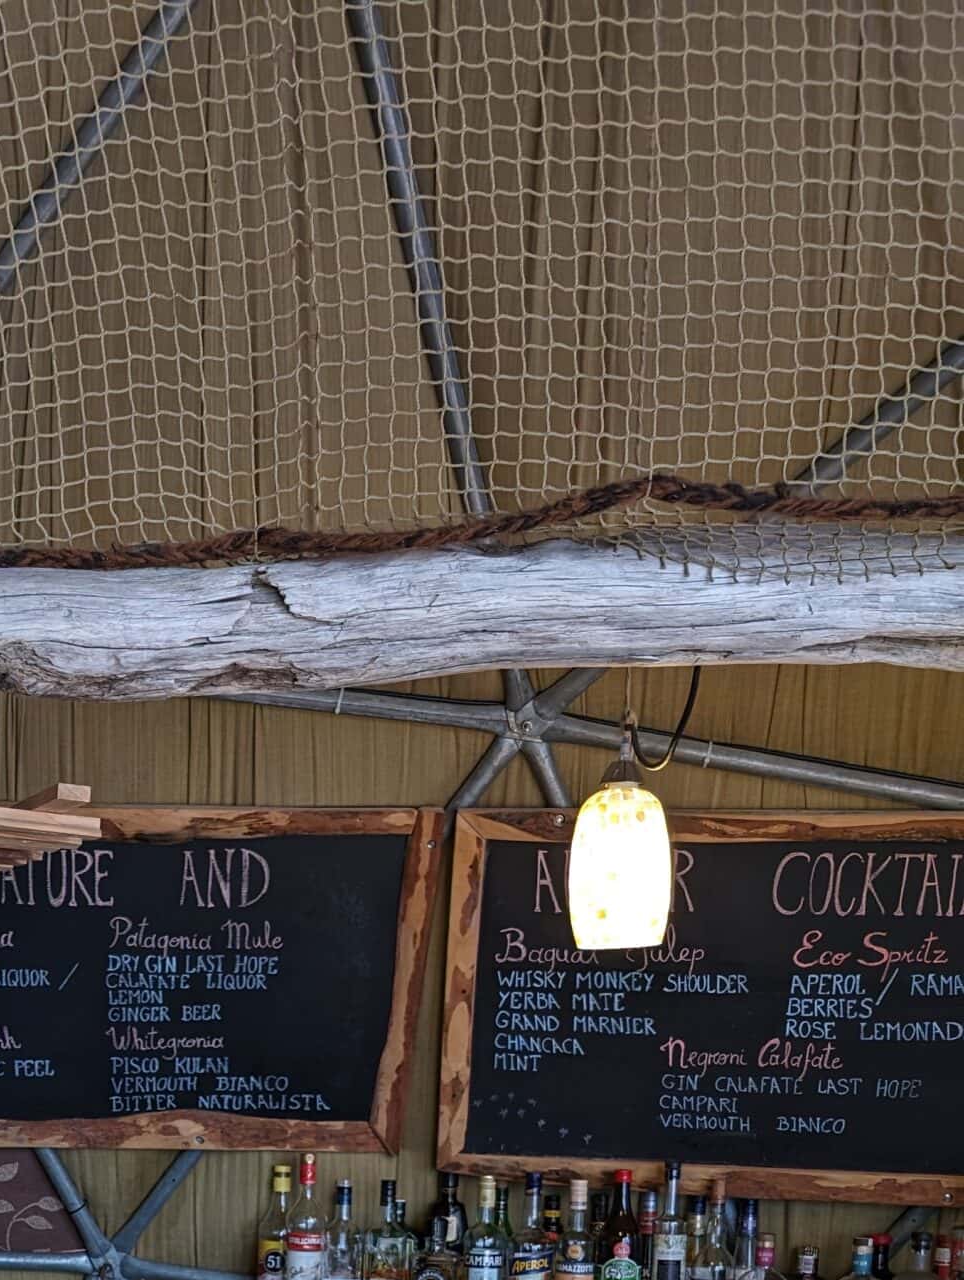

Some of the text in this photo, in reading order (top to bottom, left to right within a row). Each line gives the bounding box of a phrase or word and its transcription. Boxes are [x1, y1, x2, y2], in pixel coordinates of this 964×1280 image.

[180, 848, 270, 909] AND
[772, 852, 964, 917] COCKTAI
[109, 916, 284, 958] Patagonia Mule
[107, 954, 279, 975] DRY GIN LAST HOPE
[793, 929, 949, 983] Eco Spritz
[206, 973, 267, 990] LIQUOR
[496, 970, 749, 994] WHISKY MONKEY SHOULDER
[790, 973, 866, 996] APEROL
[108, 989, 164, 1006] LEMON
[498, 991, 626, 1011] YERBA MATE
[108, 1004, 222, 1022] GINGER BEER
[786, 998, 874, 1019] BERRIES
[495, 1011, 657, 1035] GRAND MARNIER
[785, 1019, 836, 1040] ROSE
[494, 1033, 585, 1056] CHANCACA
[14, 1059, 56, 1077] PEEL
[110, 1056, 229, 1075] PISCO KULAN
[493, 1053, 542, 1072] MINT
[659, 1036, 844, 1079] Negroni Calafate
[111, 1075, 289, 1094] VERMOUTH BIANCO
[661, 1074, 922, 1098] GIN CALAFATE LAST HOPE
[109, 1095, 331, 1112] BITTER NATURALISTA
[659, 1095, 737, 1113] CAMPARI
[660, 1113, 846, 1134] VERMOUTH BIANCO
[266, 1256, 281, 1268] 51
[465, 1254, 503, 1267] CAMPARI
[512, 1259, 549, 1274] APEROL
